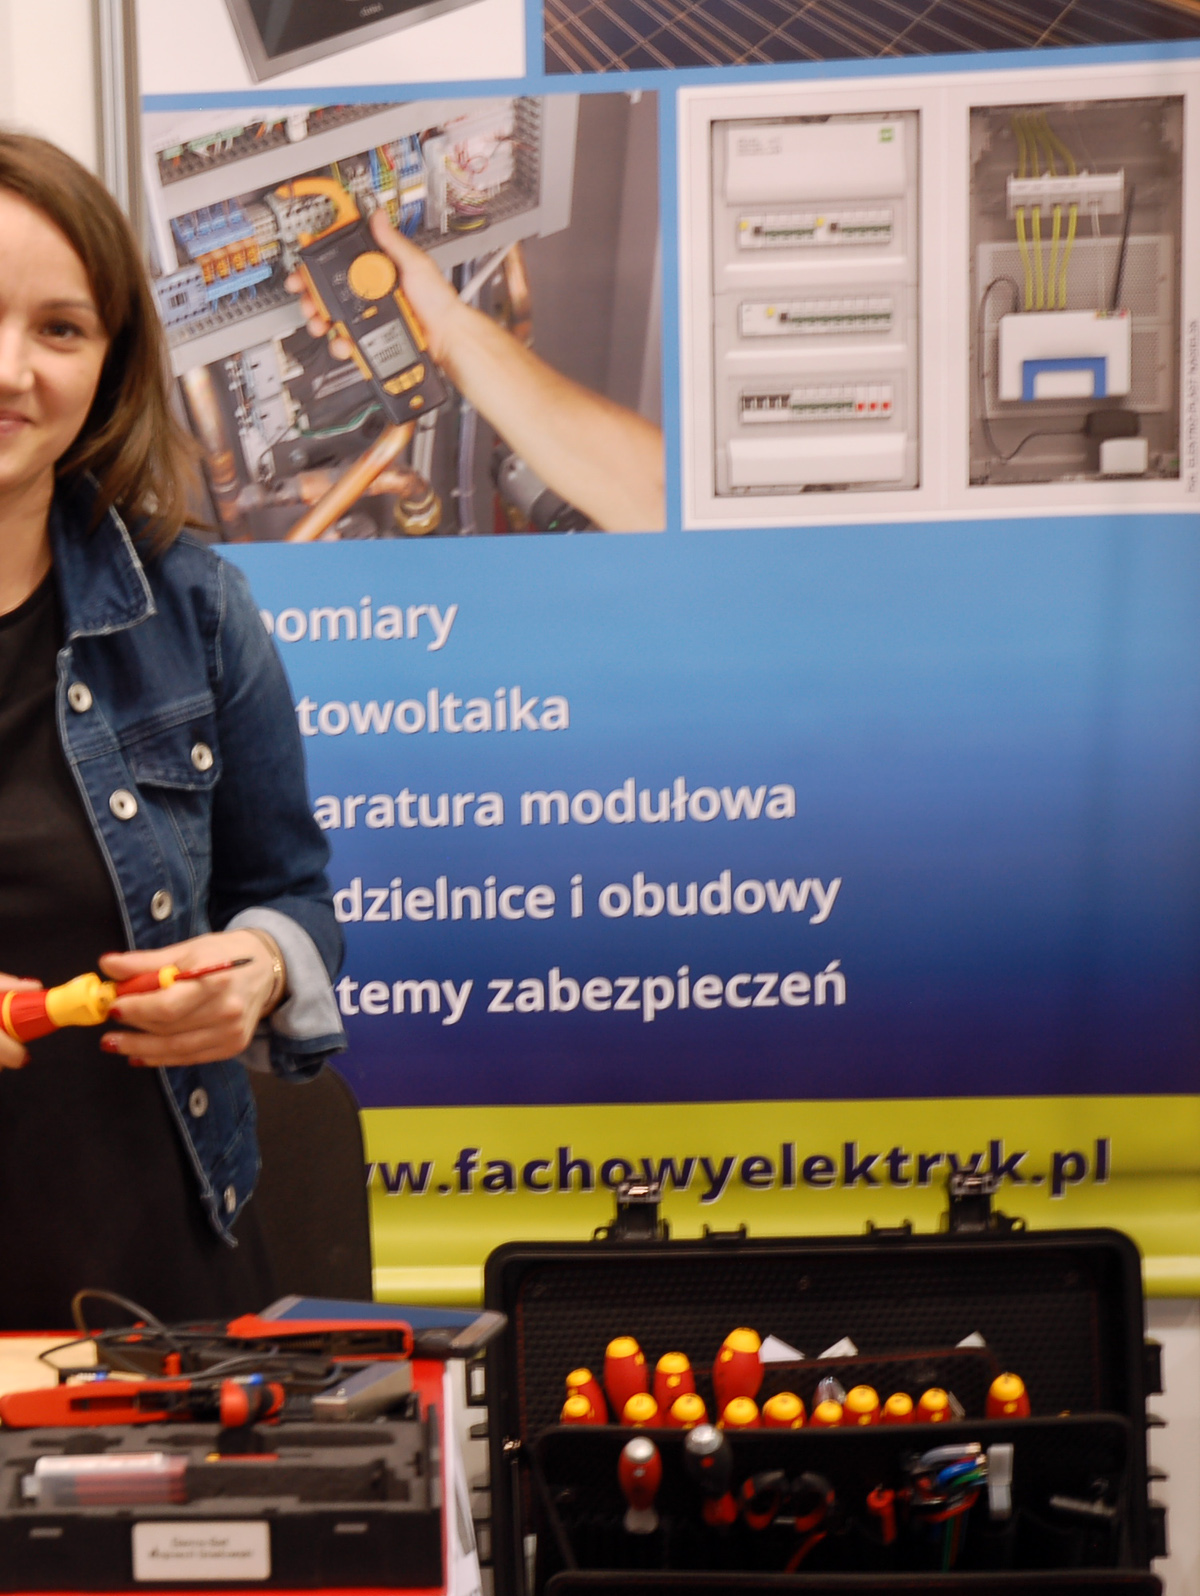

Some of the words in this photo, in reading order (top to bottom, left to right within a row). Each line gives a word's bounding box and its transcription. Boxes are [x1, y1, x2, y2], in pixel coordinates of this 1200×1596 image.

[295, 684, 571, 737] towoltaika
[313, 786, 506, 830] aratura
[520, 776, 797, 826] modułowa
[333, 875, 557, 924] dzielnice
[570, 873, 585, 919] i
[598, 869, 843, 925] obudowy
[335, 975, 474, 1025] temy
[487, 959, 848, 1023] zabezpieczeń
[364, 1136, 1112, 1206] w.fachowyelektrk.pl
